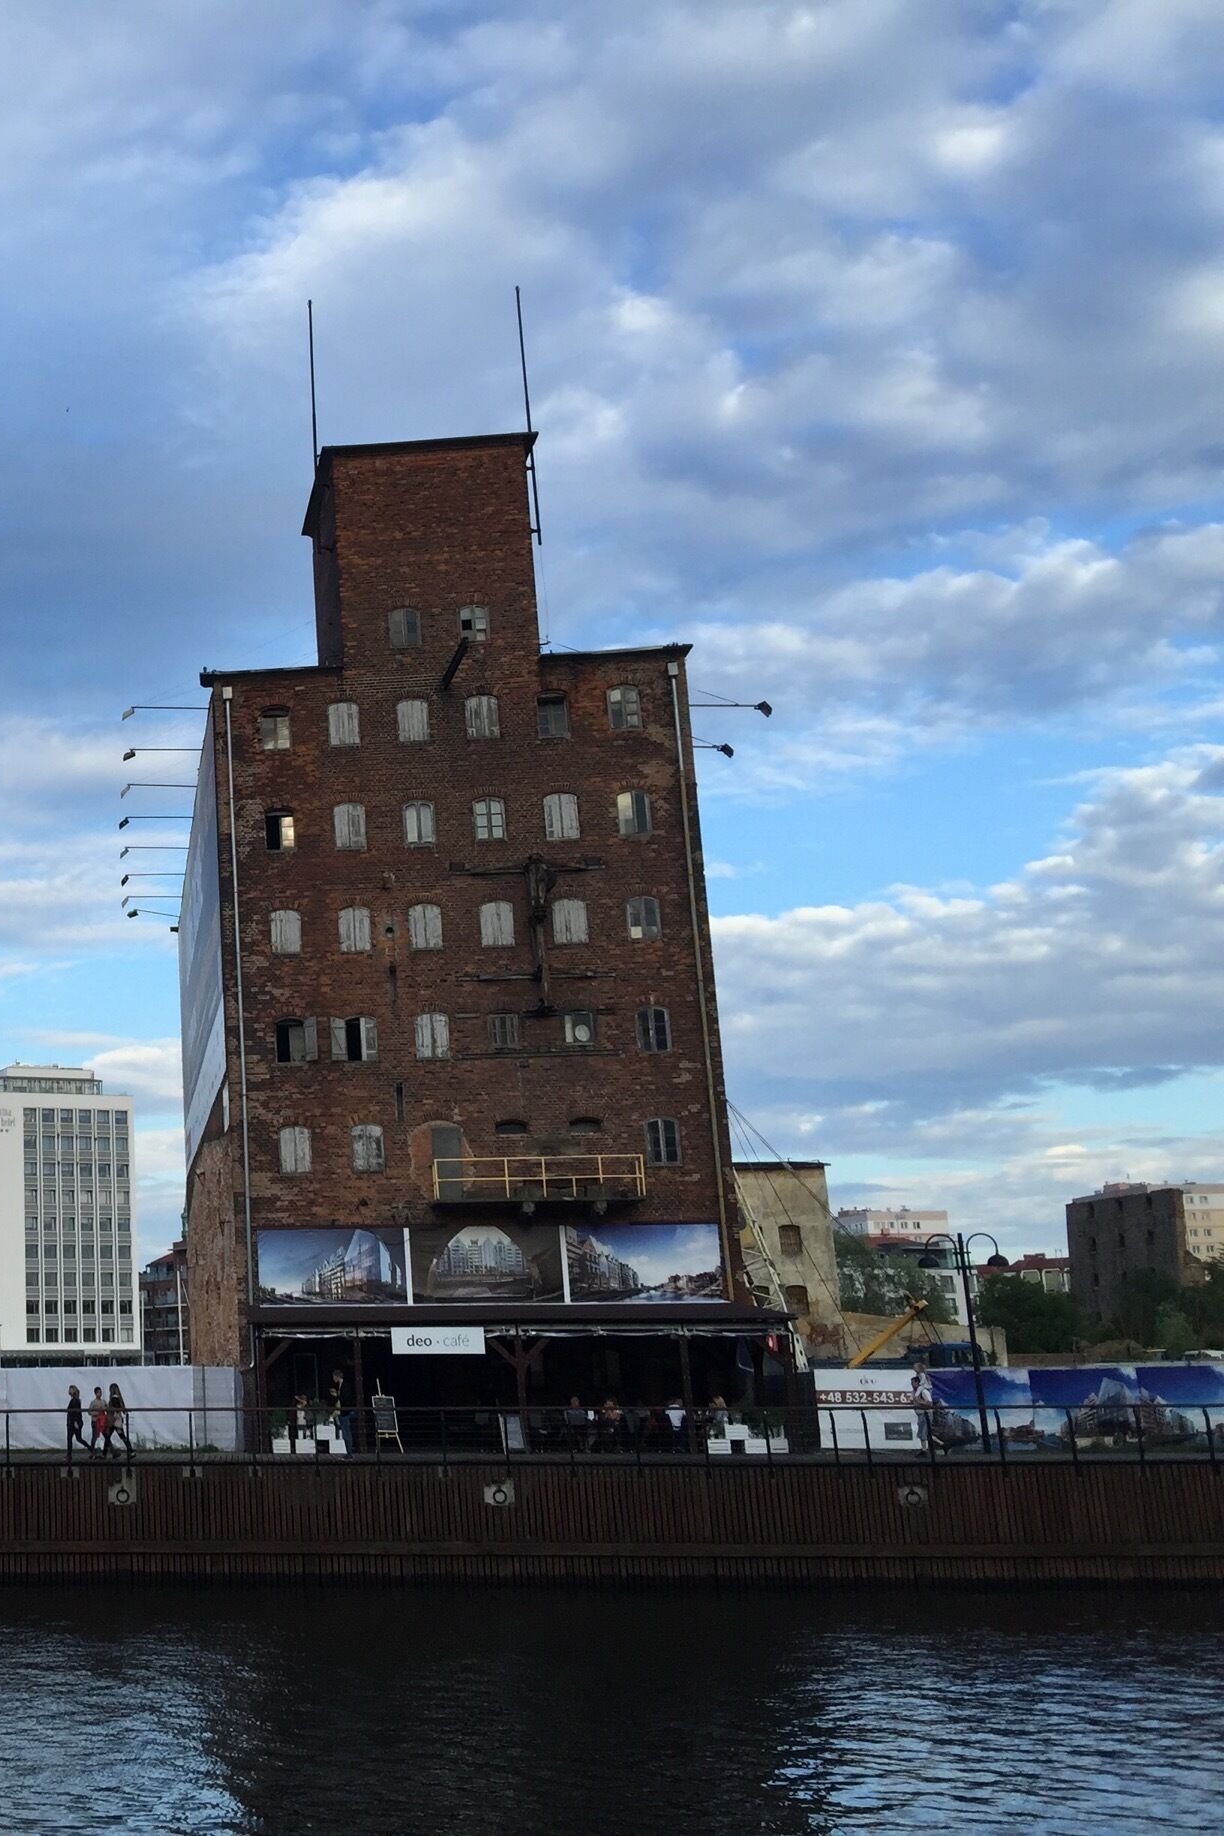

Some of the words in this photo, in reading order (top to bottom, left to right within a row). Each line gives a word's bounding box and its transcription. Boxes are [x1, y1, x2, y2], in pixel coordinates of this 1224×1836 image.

[406, 1334, 432, 1347] deo
[443, 1334, 470, 1347] café
[819, 1391, 842, 1403] +48
